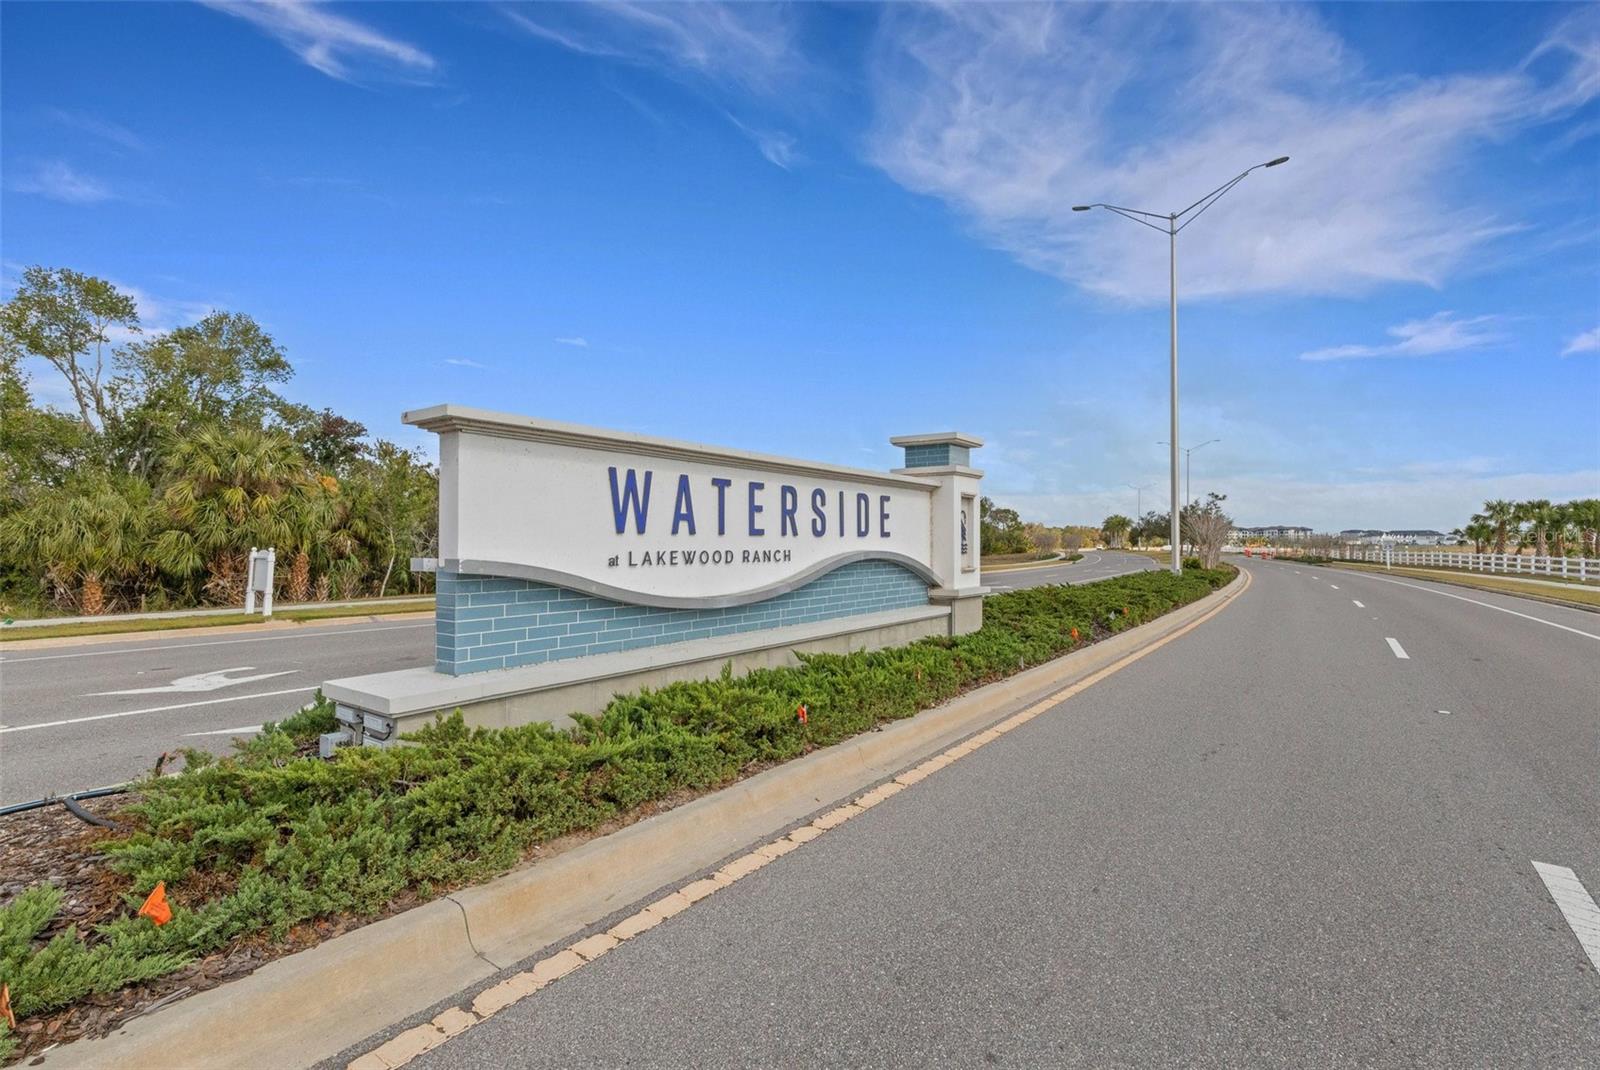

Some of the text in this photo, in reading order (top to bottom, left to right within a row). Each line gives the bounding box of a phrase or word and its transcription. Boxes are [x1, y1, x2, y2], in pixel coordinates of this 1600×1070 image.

[608, 466, 891, 538] WATERSIDE
[608, 549, 792, 567] at LAKEWOOD RANCH
